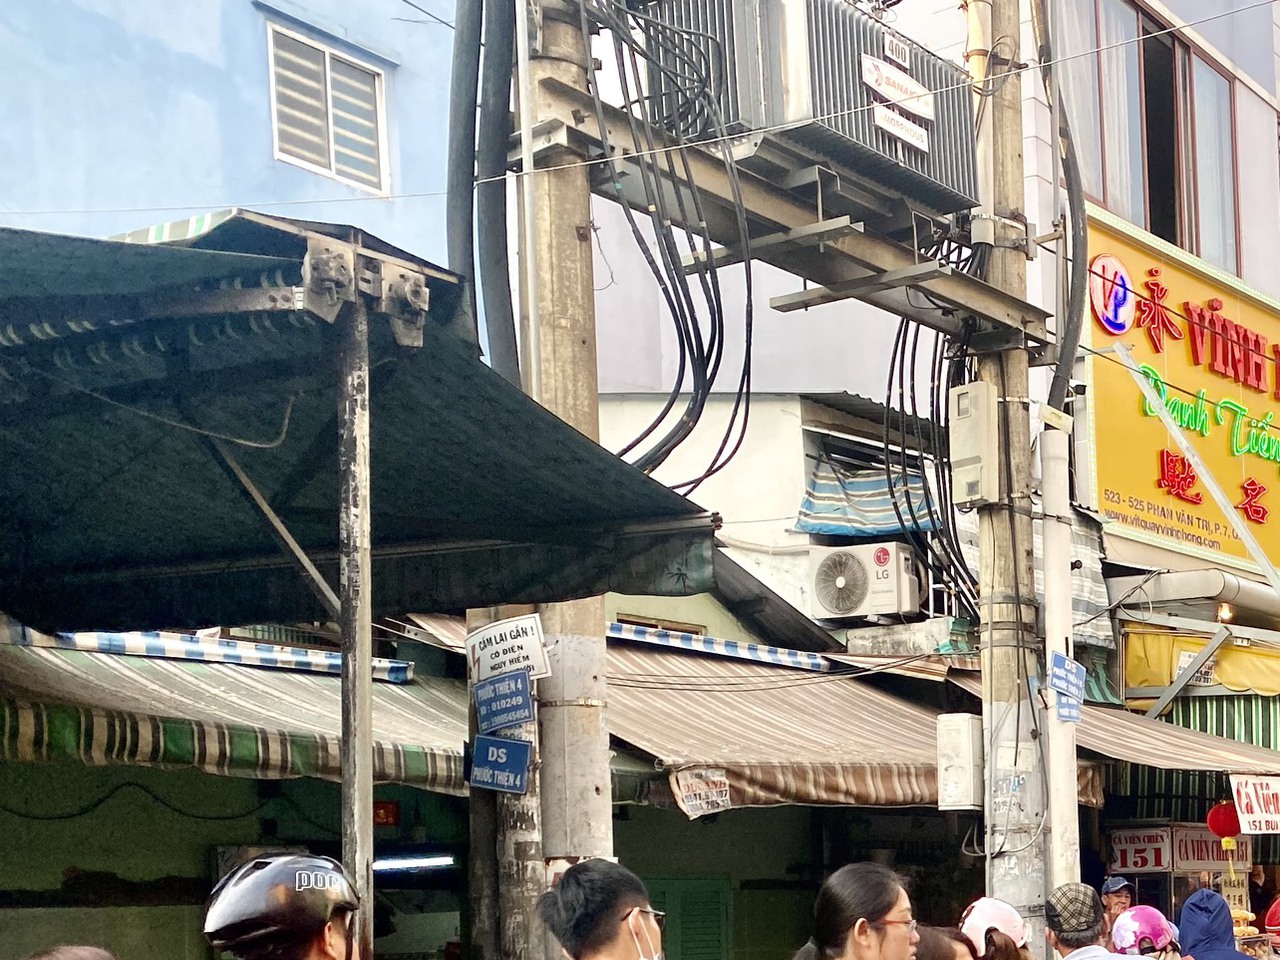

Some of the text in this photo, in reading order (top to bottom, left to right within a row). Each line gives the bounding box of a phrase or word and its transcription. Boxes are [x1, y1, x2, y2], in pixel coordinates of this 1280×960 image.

[888, 39, 907, 63] 400
[1136, 267, 1185, 353] 永
[1104, 488, 1121, 505] 523
[1128, 496, 1145, 512] 525
[1147, 502, 1173, 521] PHAN
[1175, 509, 1194, 527] VĂN
[875, 569, 889, 580] LG
[490, 660, 507, 673] NGUY
[1065, 659, 1078, 673] DS
[516, 679, 523, 691] 4
[491, 696, 523, 711] 010249
[488, 746, 507, 763] DS
[514, 775, 521, 788] 4
[1236, 779, 1254, 815] Cá
[1252, 782, 1280, 816] Viên
[1247, 820, 1262, 831] 151
[1118, 847, 1164, 869] 151
